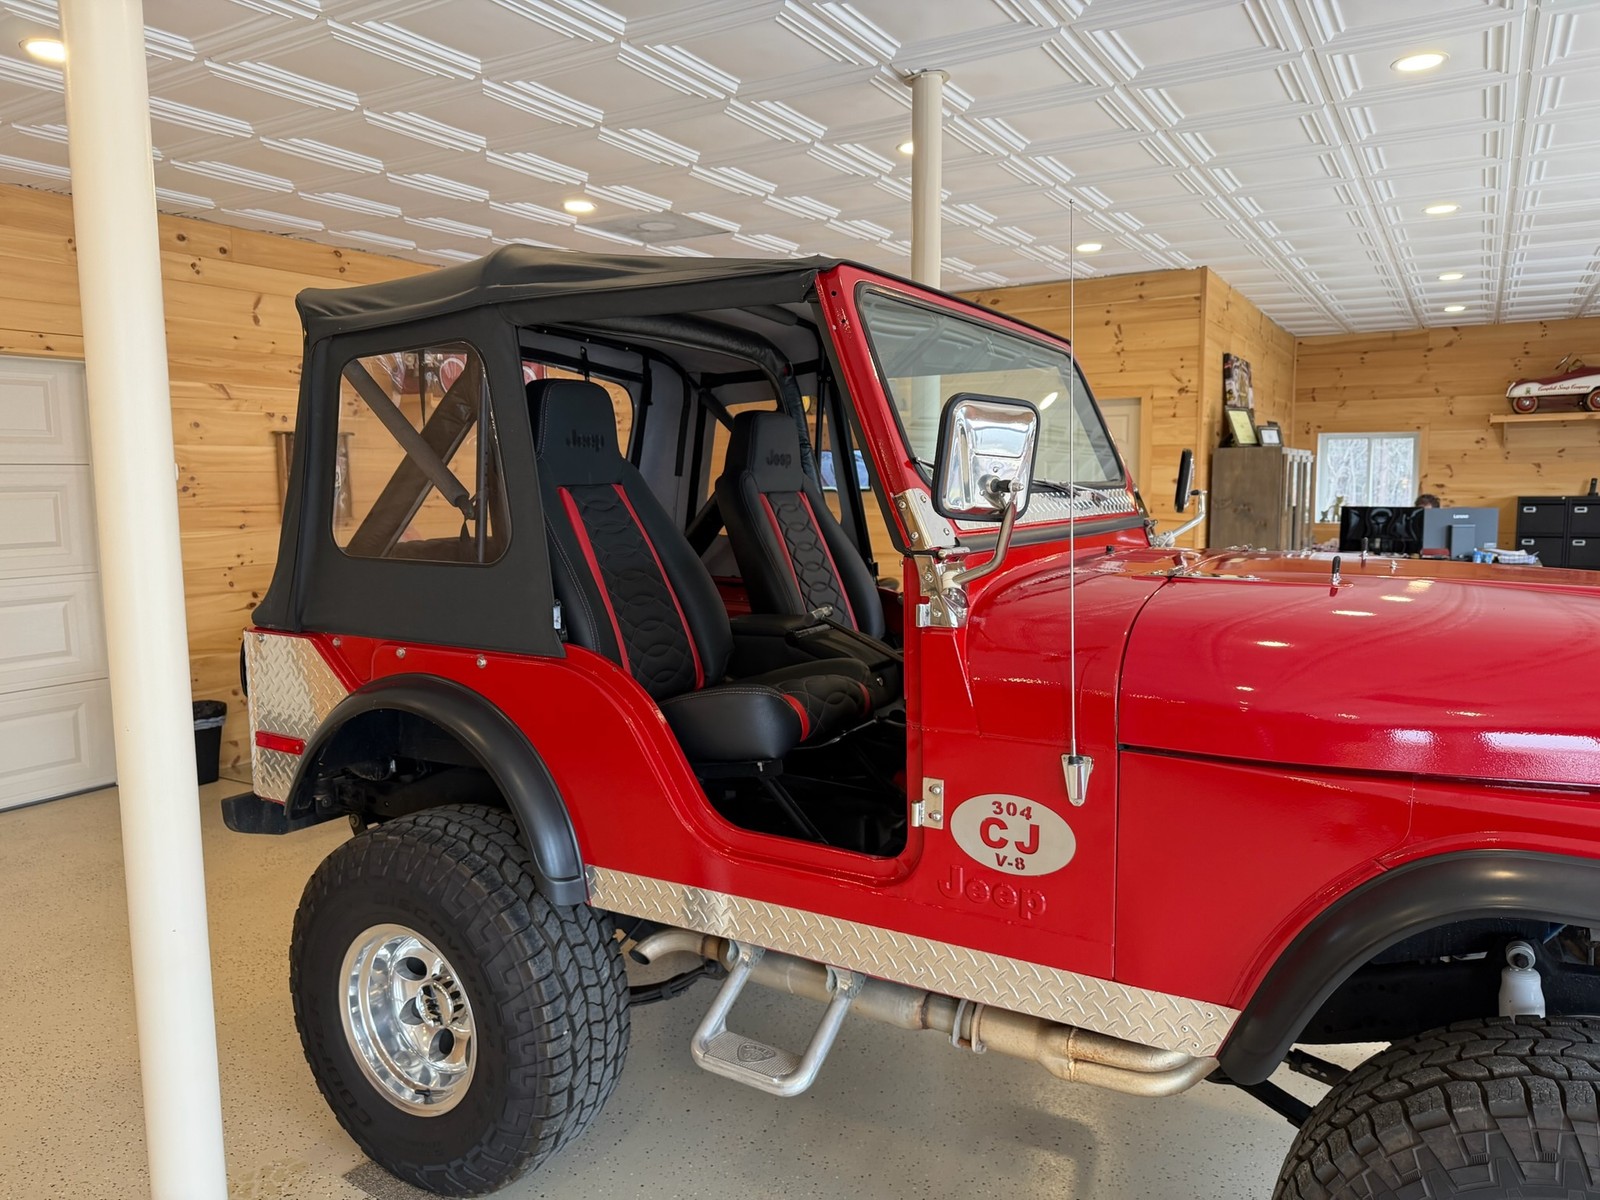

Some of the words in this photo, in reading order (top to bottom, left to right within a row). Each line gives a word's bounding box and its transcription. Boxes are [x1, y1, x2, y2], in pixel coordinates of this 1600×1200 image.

[565, 429, 605, 452] Jeep
[765, 449, 792, 469] Jeep
[992, 800, 1032, 820] 304
[995, 852, 1026, 871] V-8
[937, 864, 1046, 920] Jeep
